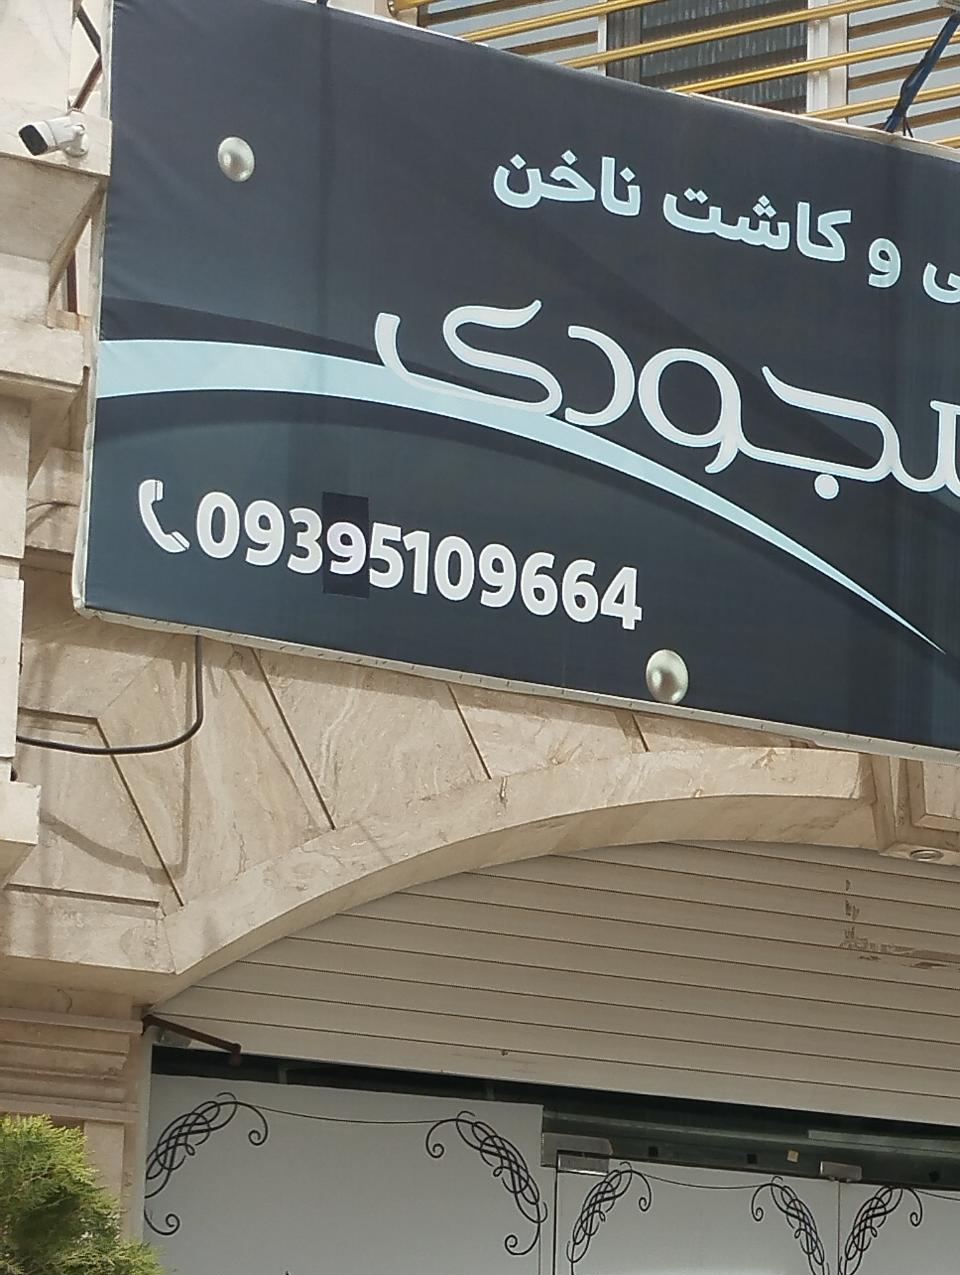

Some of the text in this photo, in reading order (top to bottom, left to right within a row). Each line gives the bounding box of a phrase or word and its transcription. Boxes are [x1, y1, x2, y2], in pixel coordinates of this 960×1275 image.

[493, 149, 641, 217] ناخن
[662, 187, 852, 262] کاشت
[868, 237, 901, 288] و
[197, 491, 643, 631] 09395109664
